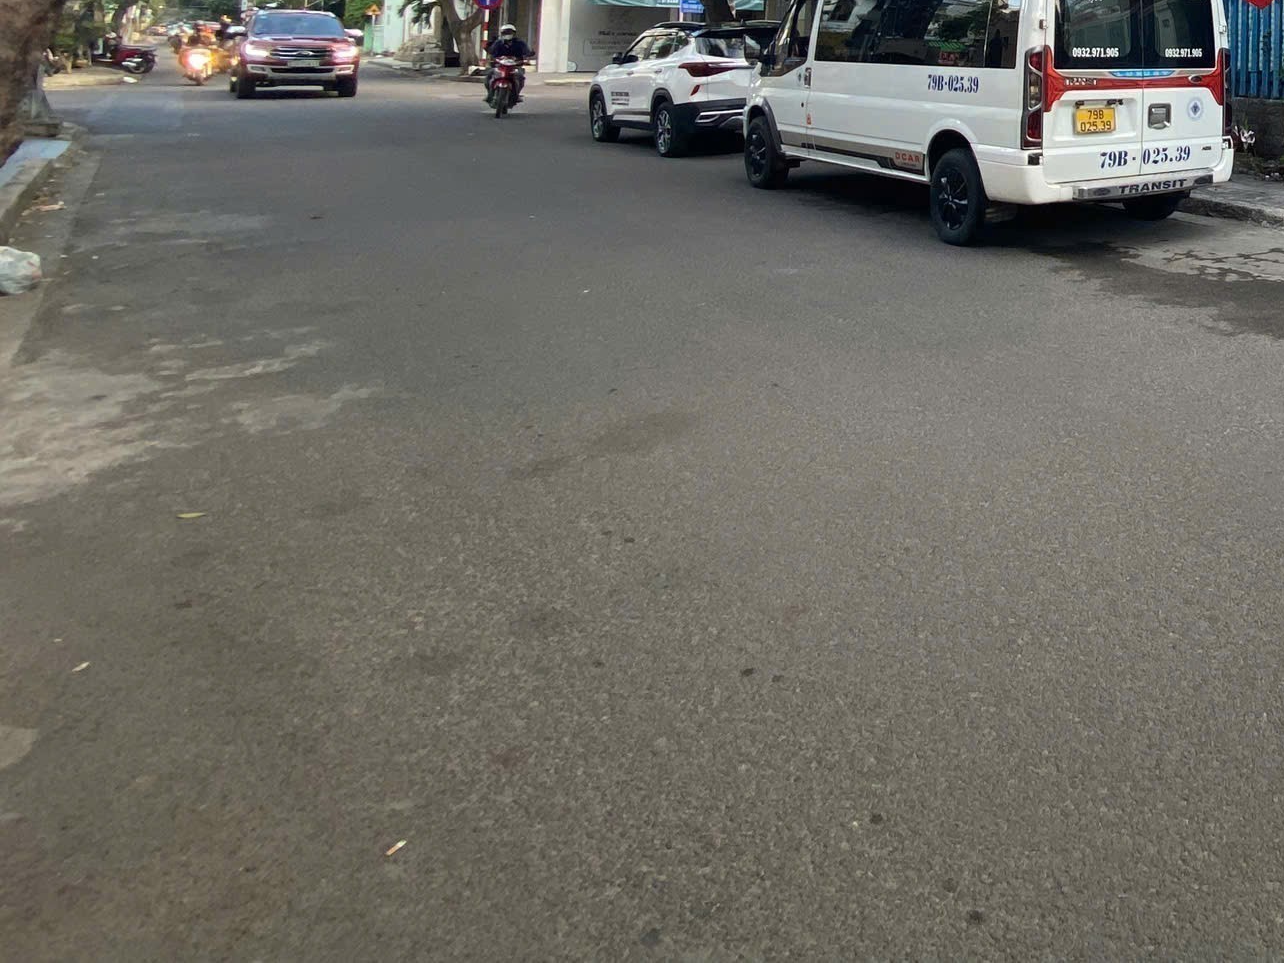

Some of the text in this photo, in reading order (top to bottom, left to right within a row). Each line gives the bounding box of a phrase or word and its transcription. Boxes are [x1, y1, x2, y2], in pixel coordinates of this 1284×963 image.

[1072, 47, 1119, 58] 0932.971.905
[1165, 48, 1202, 58] 0932.971.905
[1087, 110, 1104, 120] 79B
[1080, 121, 1112, 133] 025.39
[1100, 150, 1128, 169] 79B
[1142, 145, 1191, 165] 025.39
[1119, 178, 1187, 195] TRANSIT
